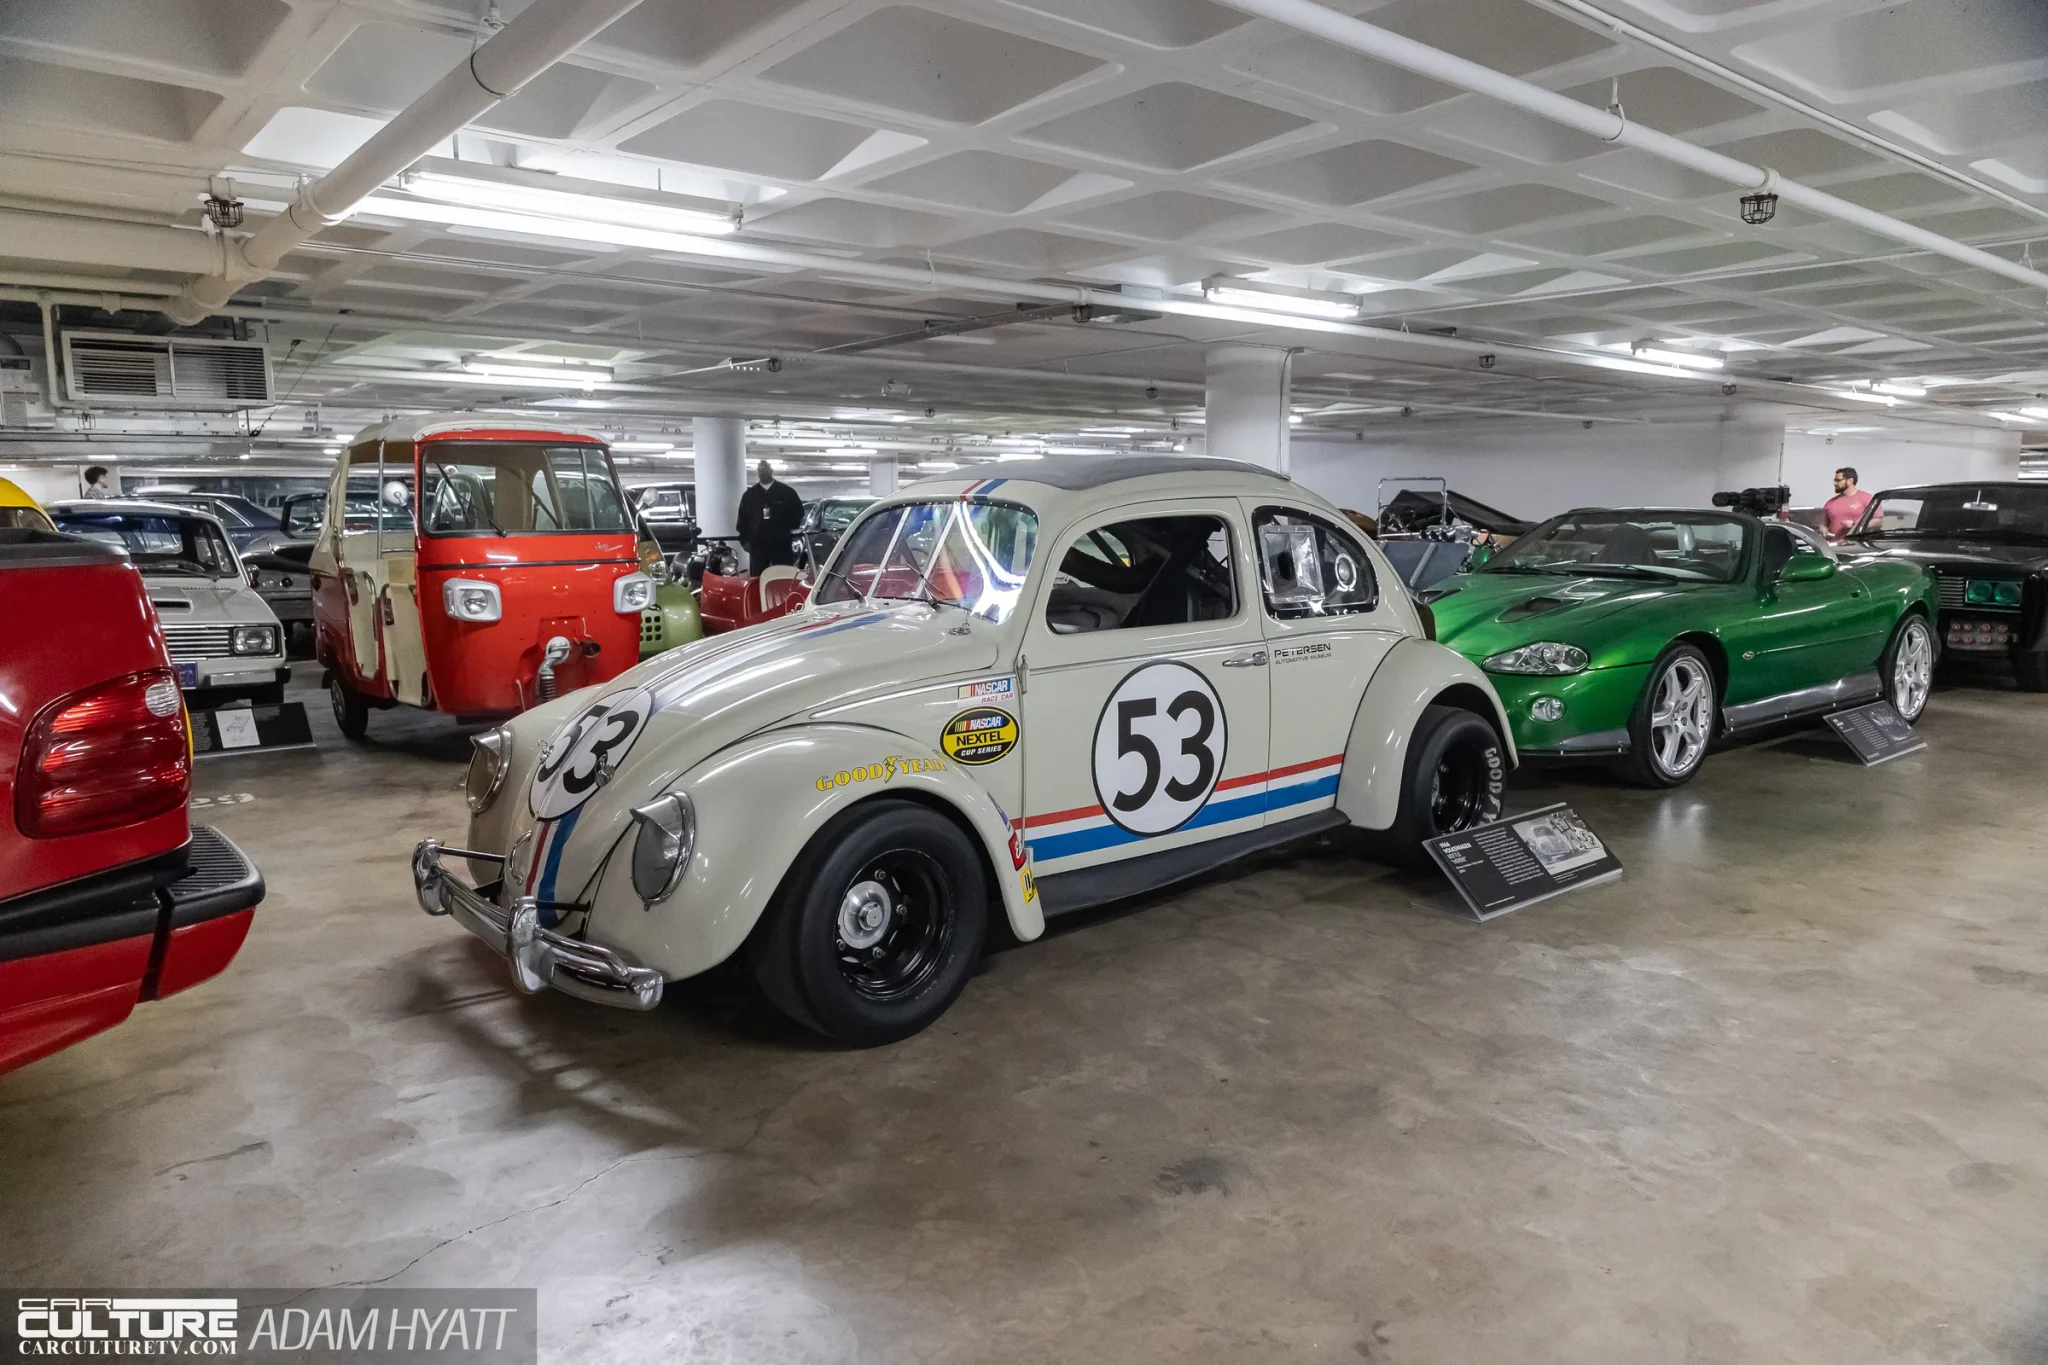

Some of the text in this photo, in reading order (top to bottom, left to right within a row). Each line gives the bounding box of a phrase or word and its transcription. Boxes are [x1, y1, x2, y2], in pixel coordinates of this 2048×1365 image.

[1274, 643, 1331, 658] PETERSEN
[1275, 656, 1309, 665] AUTOMOTIVE
[974, 680, 1008, 697] NASCAR
[981, 696, 998, 704] RACE
[970, 716, 1002, 731] NASCAR
[956, 731, 1004, 747] NEXTEL
[538, 704, 640, 794] 53
[977, 745, 1002, 755] SERIES
[1112, 690, 1215, 812] 53
